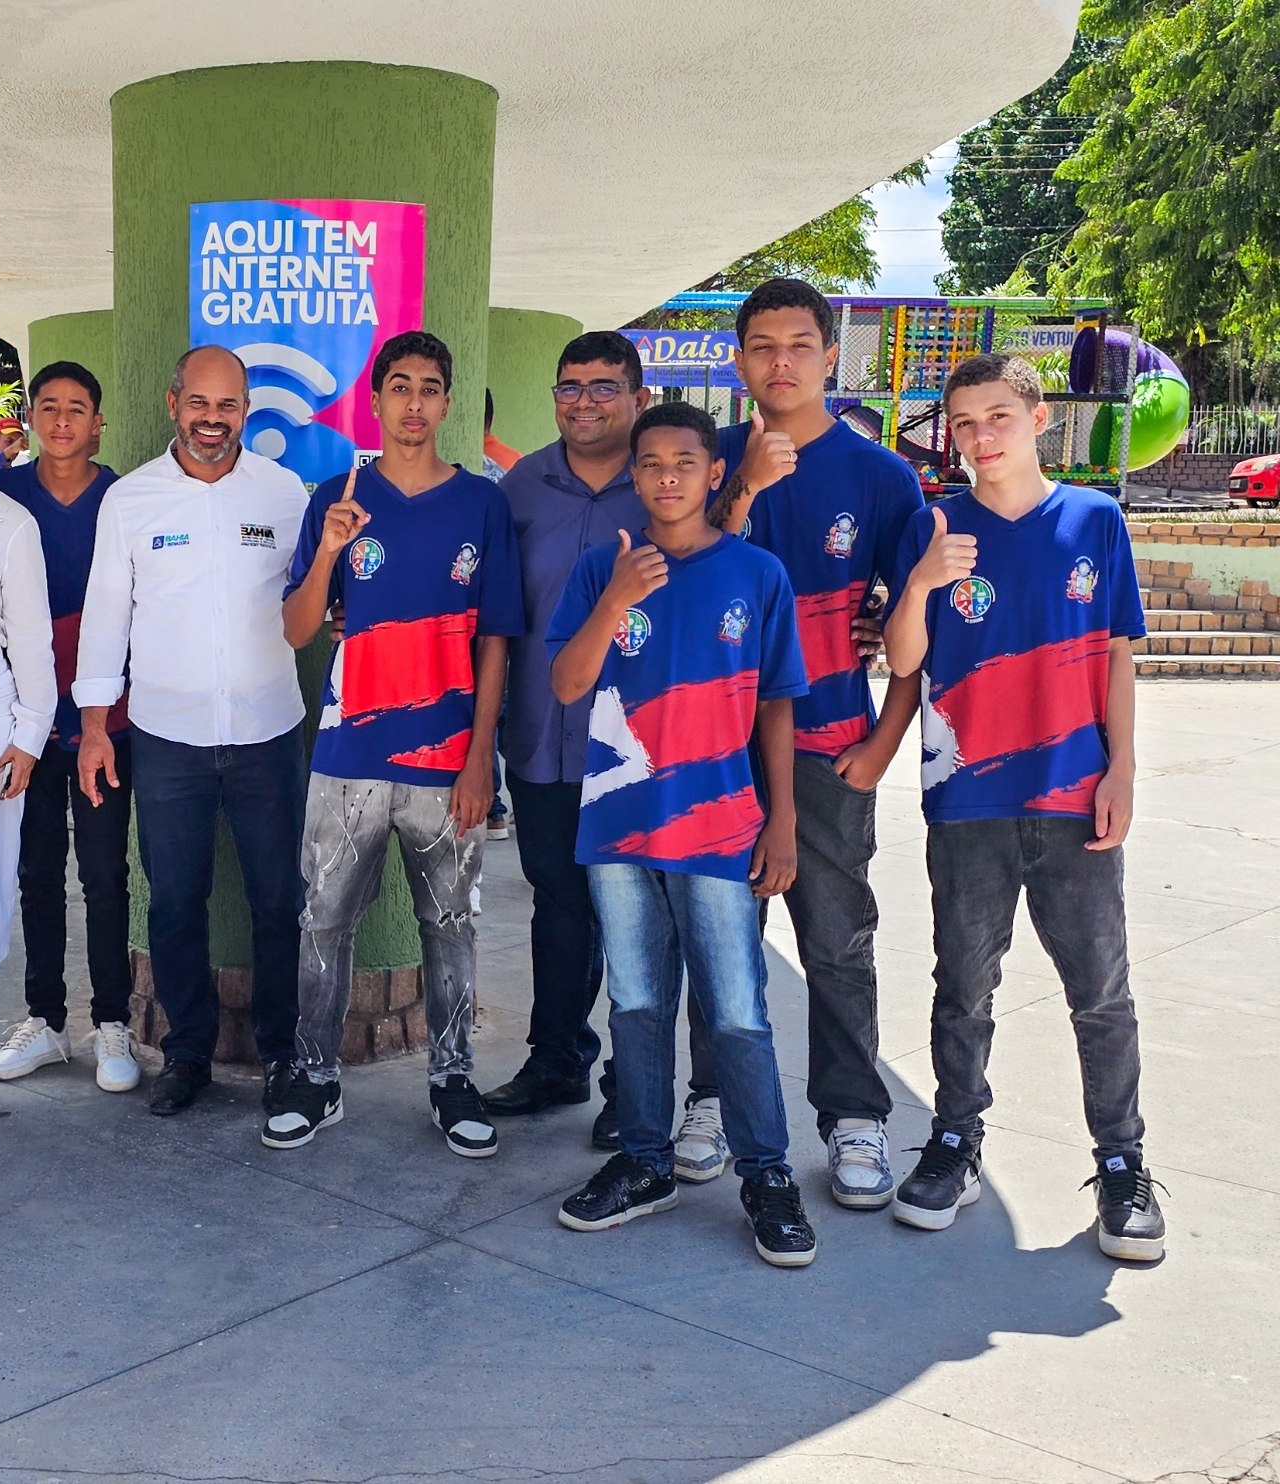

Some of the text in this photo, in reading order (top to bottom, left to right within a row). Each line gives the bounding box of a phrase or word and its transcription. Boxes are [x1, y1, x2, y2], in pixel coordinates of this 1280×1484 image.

[200, 219, 377, 255] AQUI TEM
[201, 256, 374, 290] INTERNET
[200, 291, 379, 325] GRATUITA
